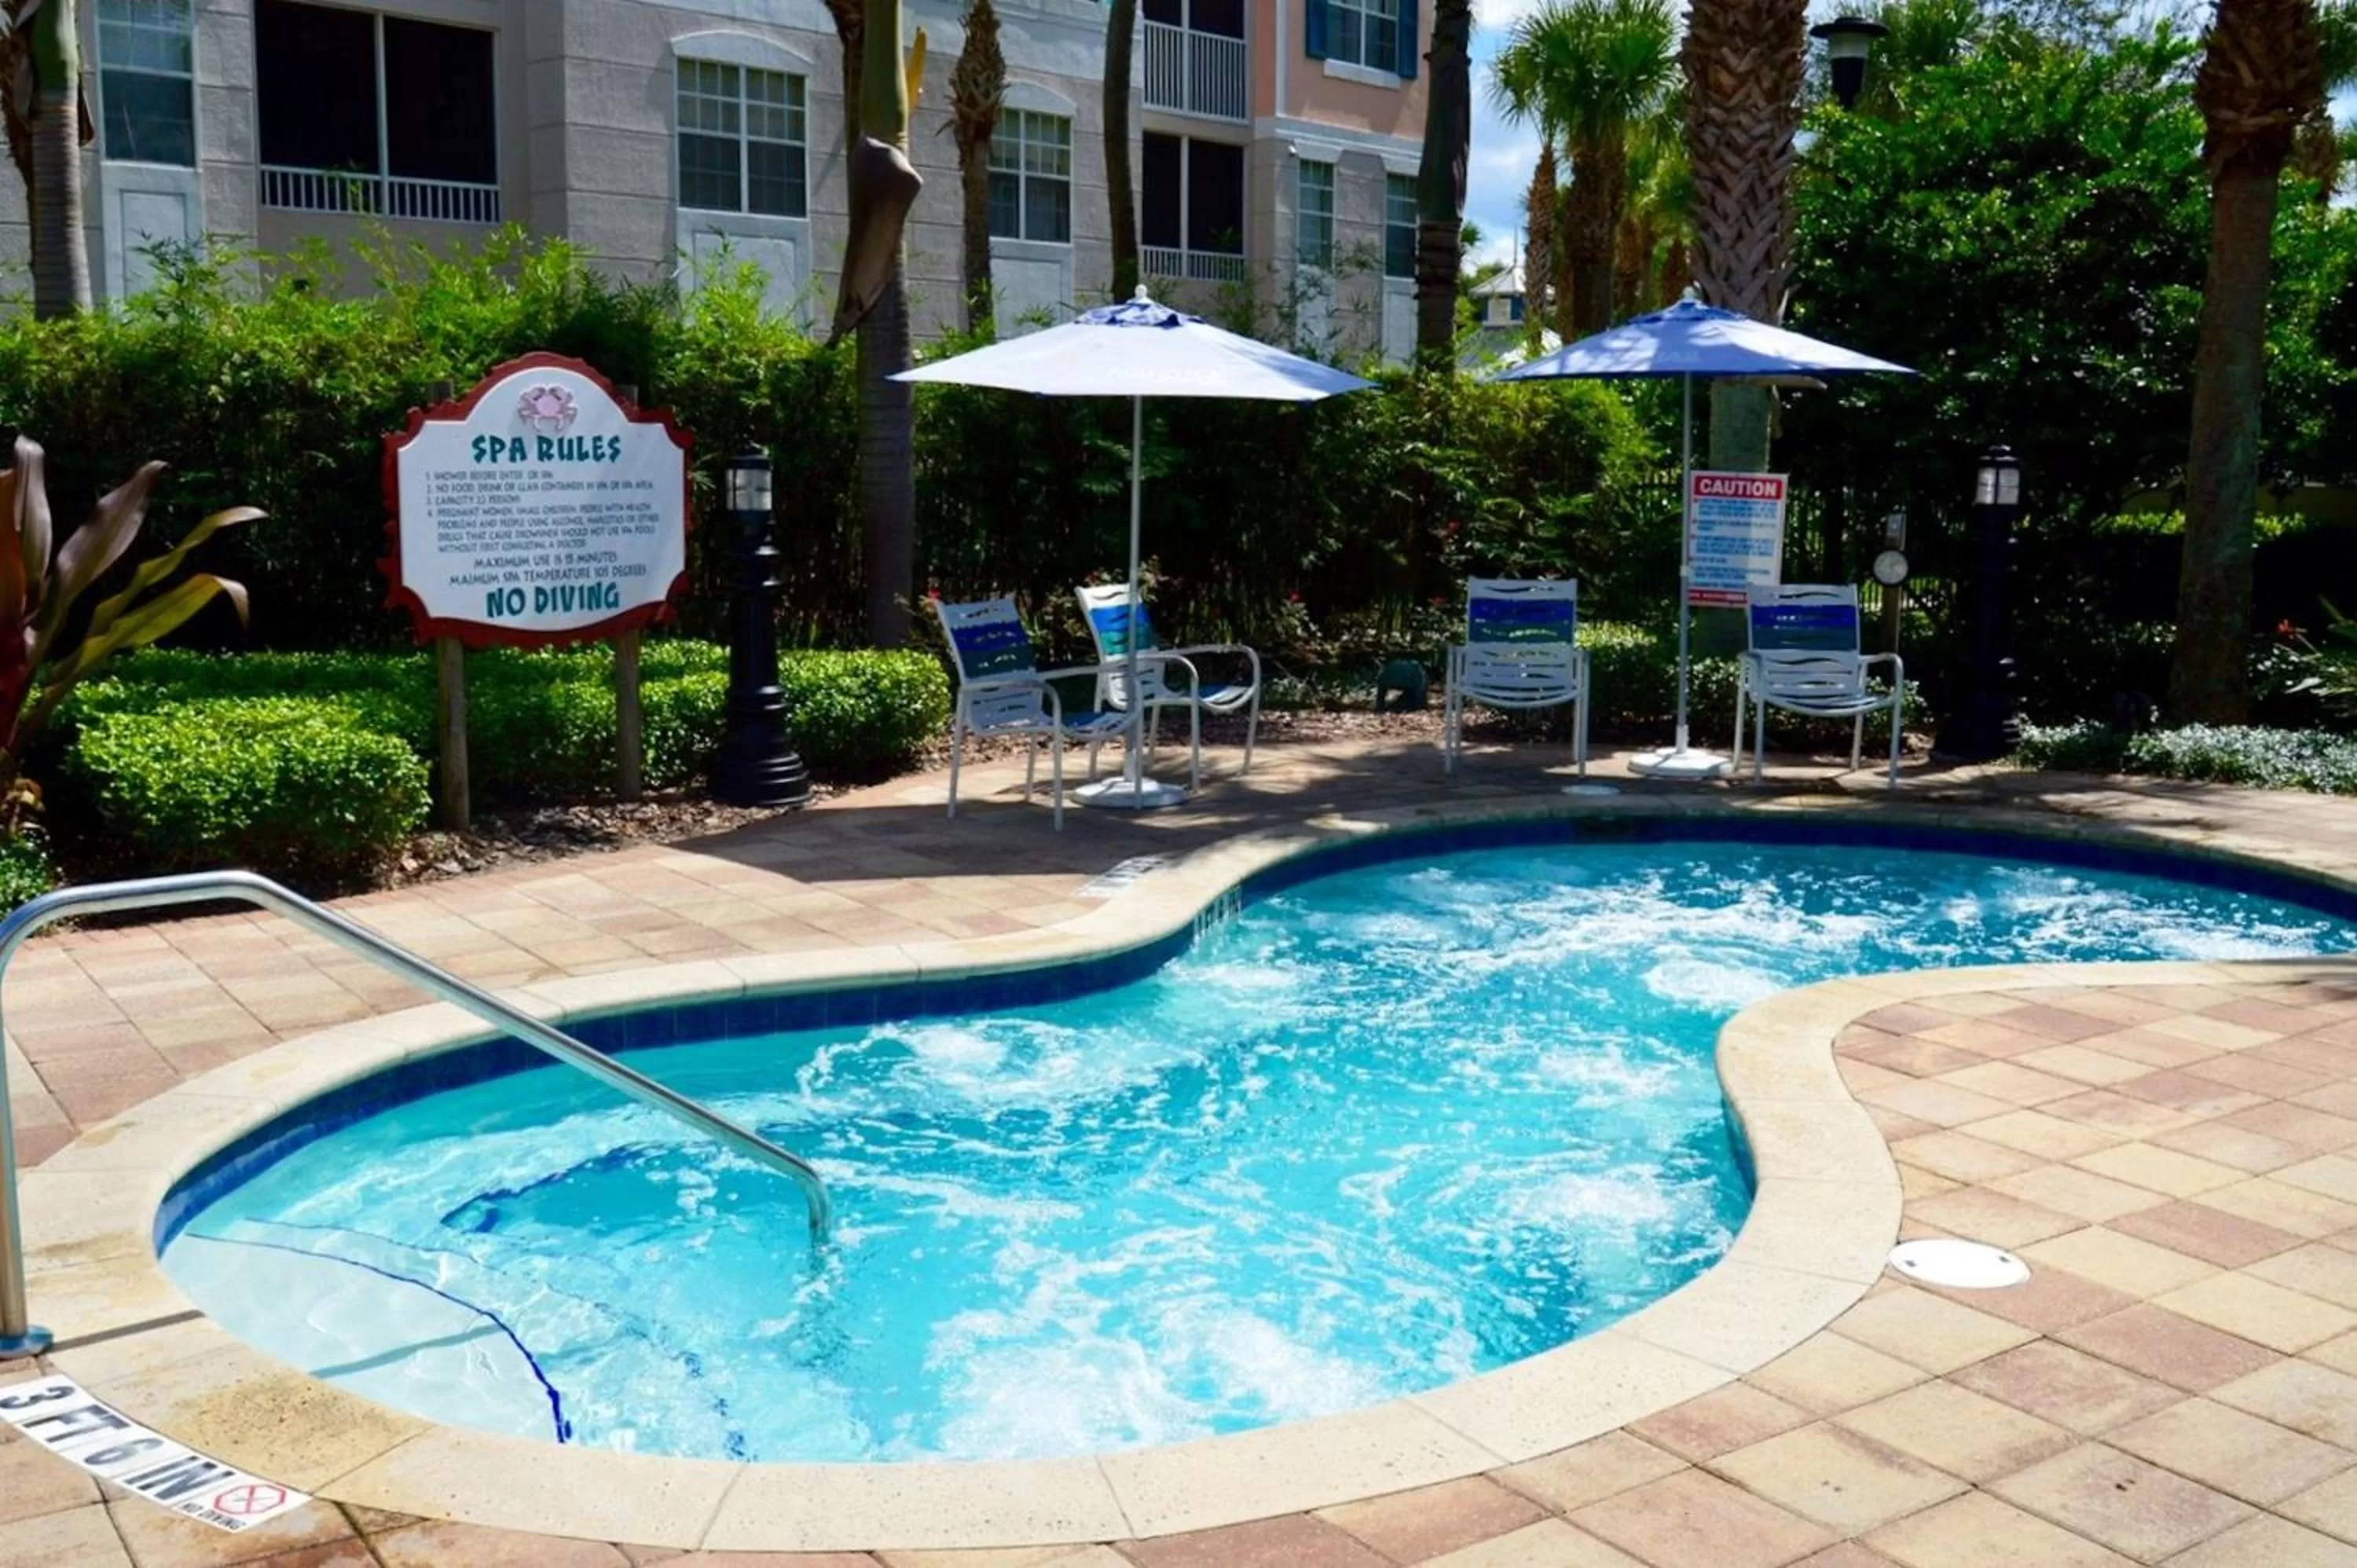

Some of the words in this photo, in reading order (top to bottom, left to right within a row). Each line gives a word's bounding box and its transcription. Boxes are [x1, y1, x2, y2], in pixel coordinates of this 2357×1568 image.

[471, 434, 527, 463] SPA
[537, 434, 622, 463] RULES
[435, 482, 449, 493] NO
[452, 482, 475, 493] FOOD
[1699, 478, 1777, 496] CAUTION
[435, 495, 474, 505] CAPACITY
[479, 518, 497, 529] AND
[465, 530, 486, 541] THAT
[475, 555, 531, 567] MAXIMUM
[533, 553, 549, 566] USE
[503, 570, 519, 583] SPA
[524, 566, 589, 582] TEMPERATURE
[611, 563, 647, 577] DEGREES
[486, 587, 526, 617] NO
[534, 581, 620, 614] DIVING
[0, 1385, 75, 1410] 3
[22, 1403, 132, 1444] FT
[84, 1437, 165, 1467] 6
[123, 1455, 236, 1501] IN
[181, 1501, 205, 1514] NO
[198, 1508, 247, 1530] DIVING
